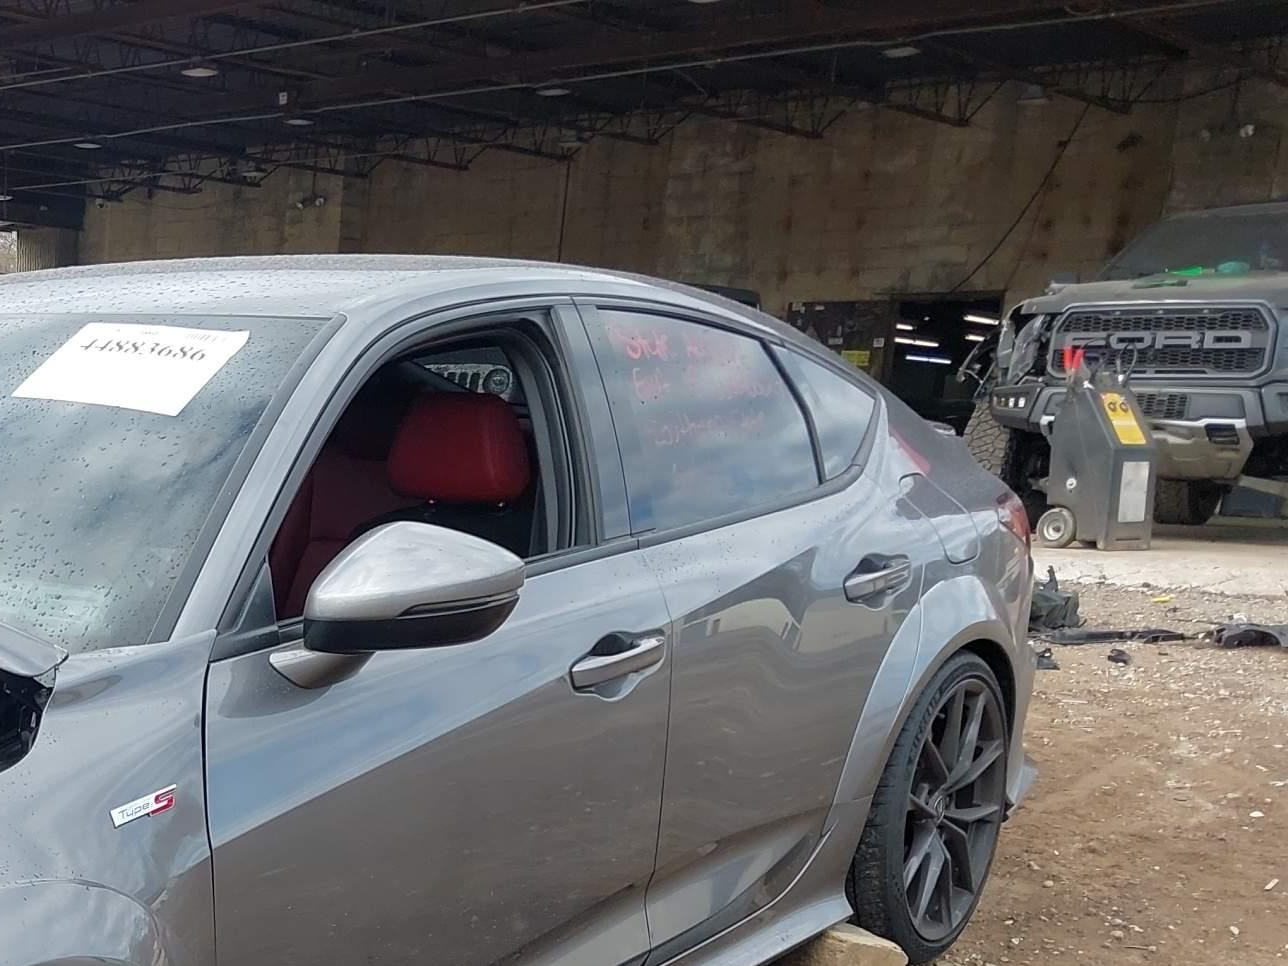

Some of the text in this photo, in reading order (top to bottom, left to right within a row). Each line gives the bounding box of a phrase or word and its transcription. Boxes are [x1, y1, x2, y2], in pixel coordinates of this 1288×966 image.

[80, 338, 206, 361] 44883686
[1065, 331, 1252, 349] FORD
[118, 792, 175, 819] Type S
